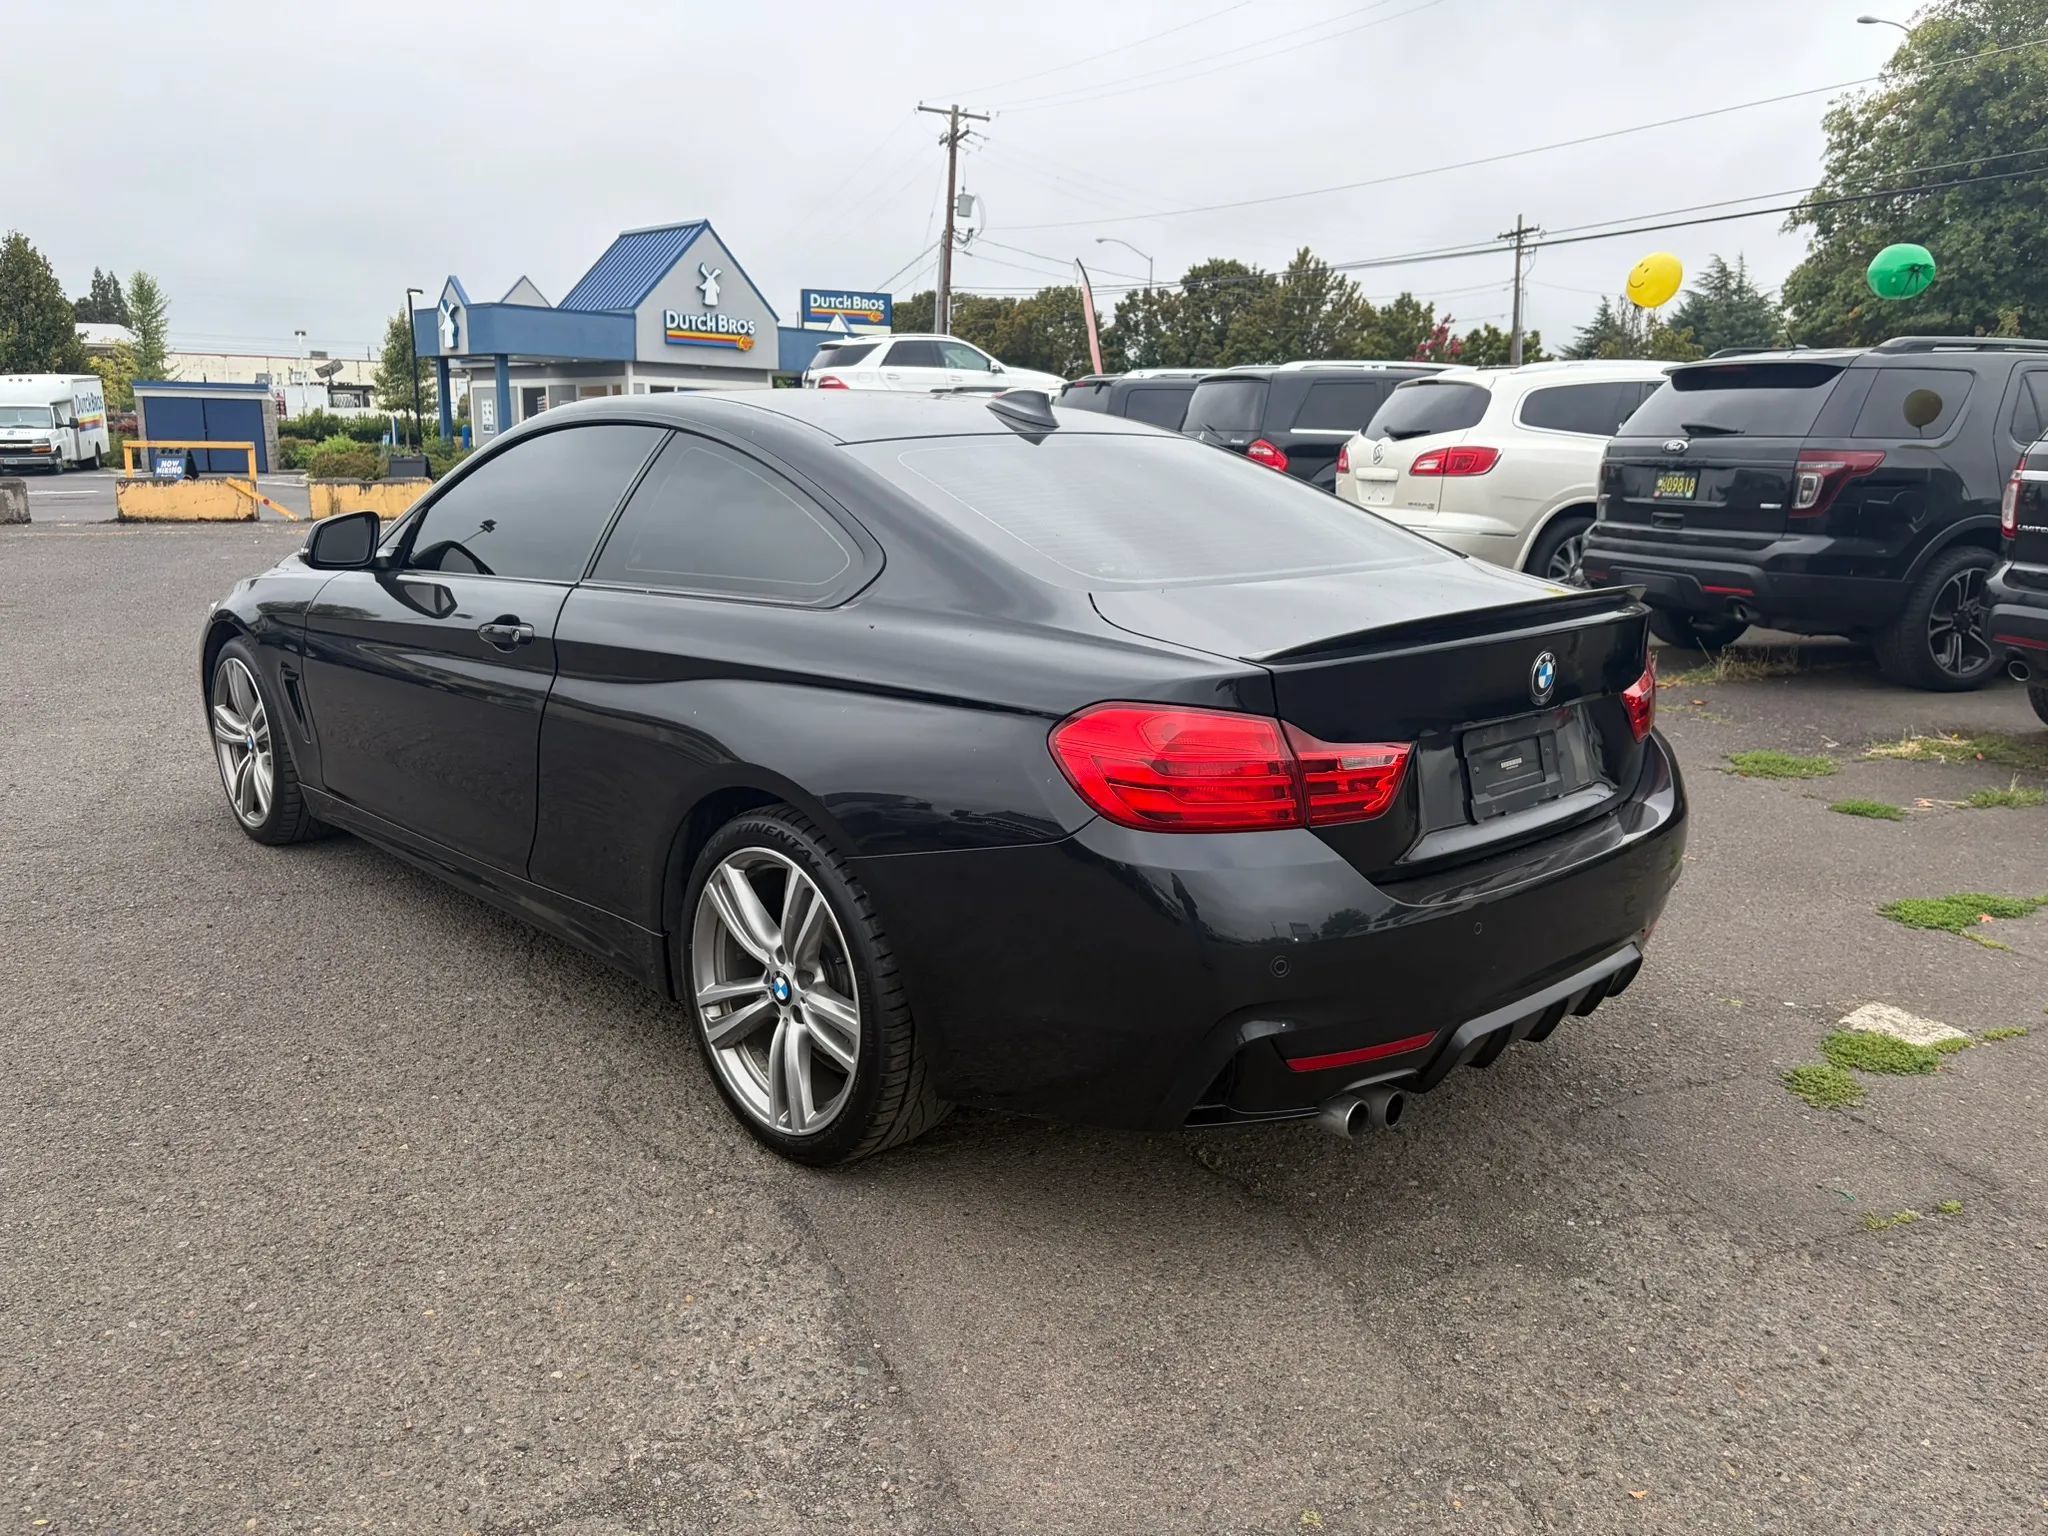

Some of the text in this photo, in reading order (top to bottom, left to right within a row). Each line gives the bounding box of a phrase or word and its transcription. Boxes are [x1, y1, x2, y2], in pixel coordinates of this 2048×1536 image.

[810, 293, 885, 310] DUTCH BROS
[665, 310, 755, 335] DUTCH BROS
[160, 460, 180, 468] NOW
